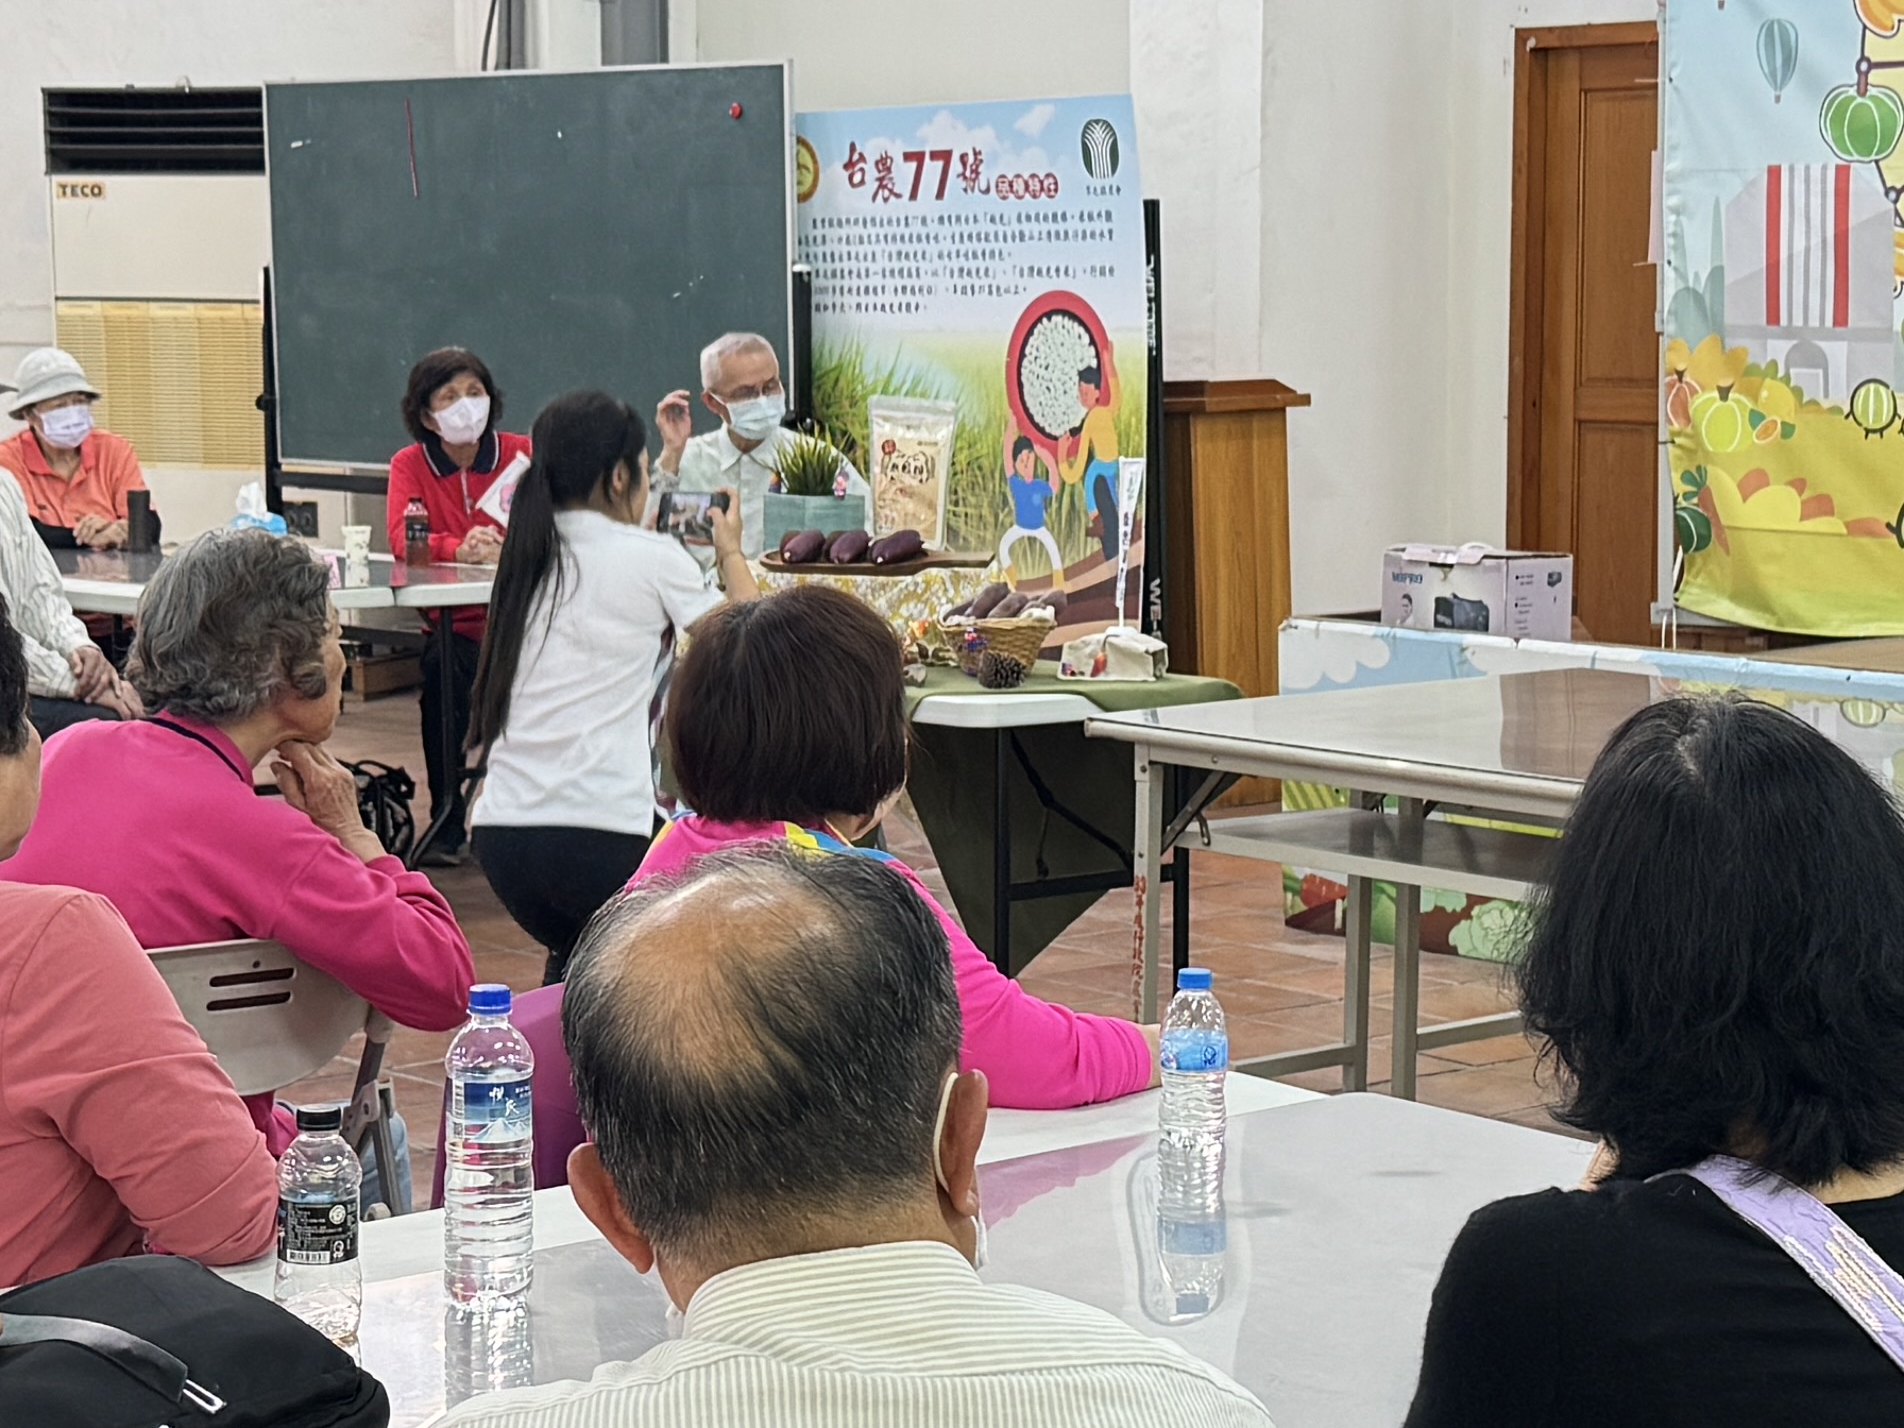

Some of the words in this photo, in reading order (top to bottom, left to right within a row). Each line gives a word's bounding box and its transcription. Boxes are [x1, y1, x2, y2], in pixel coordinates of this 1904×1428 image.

[58, 183, 103, 199] TECO
[842, 140, 991, 204] 台農77號
